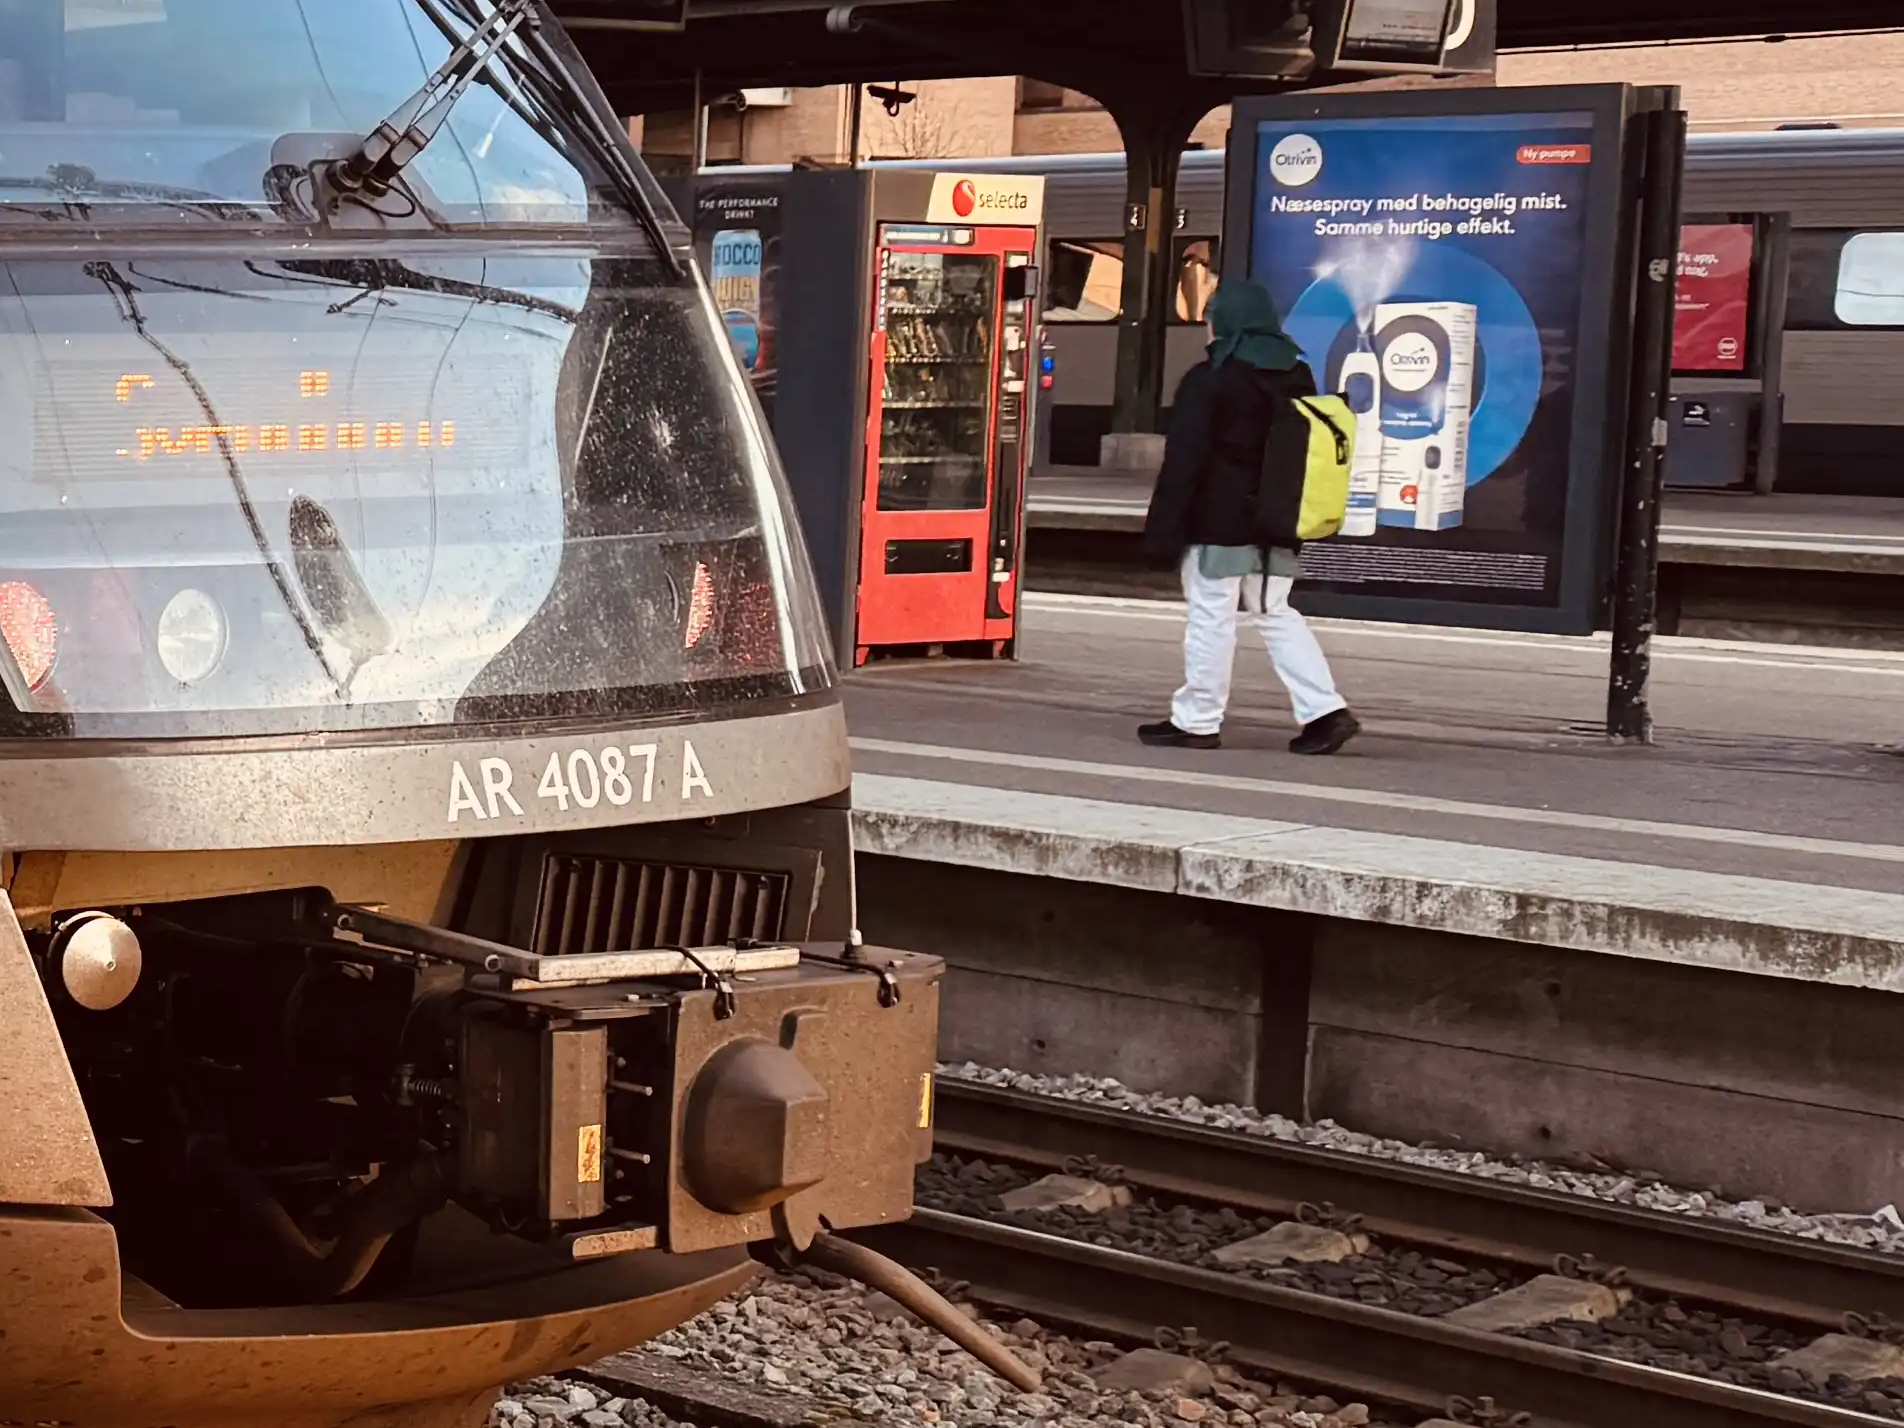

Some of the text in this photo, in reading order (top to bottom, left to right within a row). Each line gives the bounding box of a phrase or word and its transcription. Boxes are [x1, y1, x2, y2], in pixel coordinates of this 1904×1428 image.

[1275, 149, 1317, 167] Otrivin
[979, 190, 1028, 209] selecta
[1270, 192, 1568, 216] Næsespray med behagelig mist.
[1314, 216, 1516, 240] Samme hurtige effekt.
[447, 739, 714, 822] AR 4087 A
